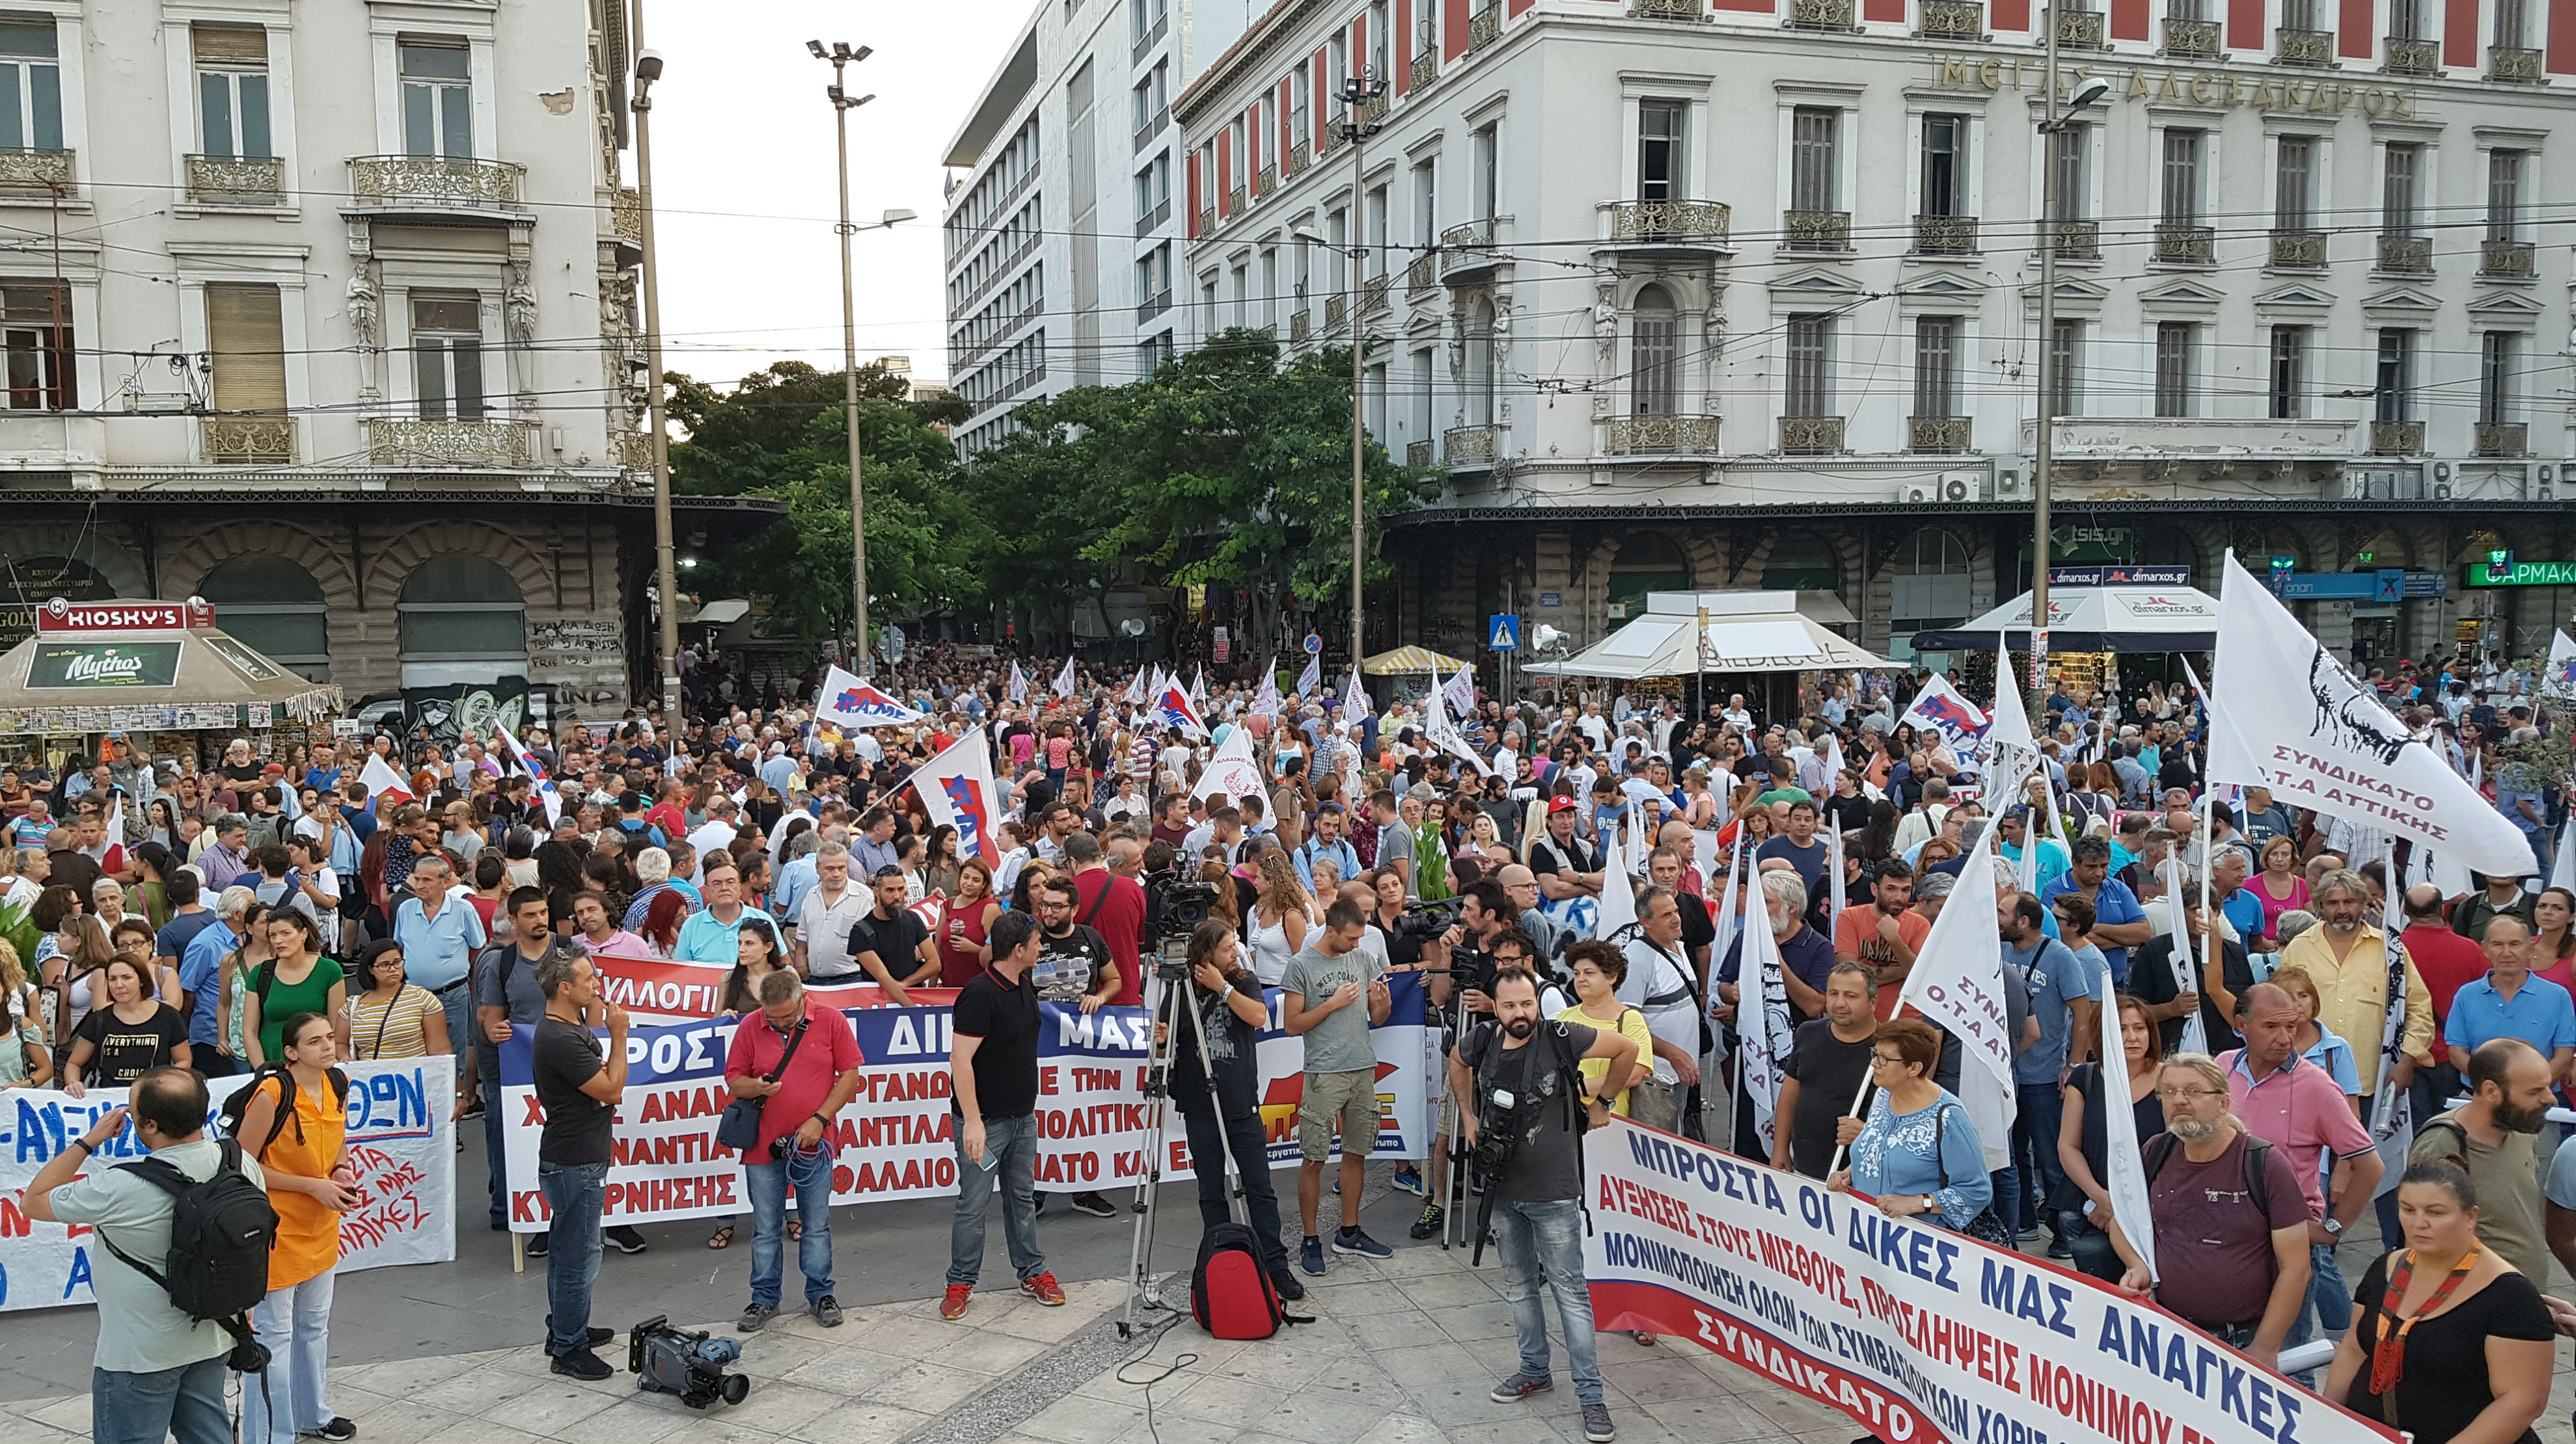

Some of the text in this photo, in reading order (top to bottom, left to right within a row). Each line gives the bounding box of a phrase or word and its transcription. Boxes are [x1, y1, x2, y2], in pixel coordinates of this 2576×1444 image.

[2128, 66, 2415, 119] ΑΛΕΞΑΝΔΡΟΣ
[2056, 571, 2100, 584] dimarxos.gr
[2132, 571, 2187, 584] dimarxos.gr
[68, 610, 177, 626] KIOSKY'S
[2015, 607, 2072, 623] dimos.gr
[2132, 604, 2204, 614] dimarxos.gr
[65, 654, 143, 681] Mythos
[532, 656, 558, 668] FREE
[2273, 744, 2435, 811] ΣΥΝΔΙΚΑΤΟ
[2323, 787, 2449, 841] ΑΤΤΙΚΗΣ
[597, 968, 718, 1013] ΥΛΛΟΓΙ
[1316, 973, 1335, 989] WEST
[1059, 1013, 1151, 1050] ΜΑΣ
[103, 1048, 119, 1056] IS A
[1071, 1067, 1121, 1092] ΤΗΝ
[346, 1067, 427, 1130] ΘΩΝ
[376, 1160, 427, 1196] ΜΑΣ
[512, 1173, 737, 1223] ΚΥΡΝΗΣΗΣ
[1627, 1129, 2305, 1444] ΜΠΡΟΣΤΑ ΟΙ ΔΙΚΕΣ ΜΑΣ ΑΝΑΓΚΕΣ
[1598, 1173, 2174, 1444] ΑΥΞΗΣΕΙΣ ΣΤΟΥΣ ΜΙΣΘΟΥΣ, ΠΡΟΣΛΗΨΕΙΣ ΜΟΝΙΜΟΥ
[1604, 1231, 1748, 1310] ΜΟΝΙΜΟΠΟΙΗΣΗ
[1749, 1280, 1798, 1336] ΟΛΩΝ
[1800, 1309, 1833, 1353] ΤΩΝ
[1830, 1321, 1969, 1441] ΣΥΜΒΑΣΙΟΥΧΩΝ
[1693, 1309, 1915, 1441] ΣΥΝΔΙΚΑΤΟ
